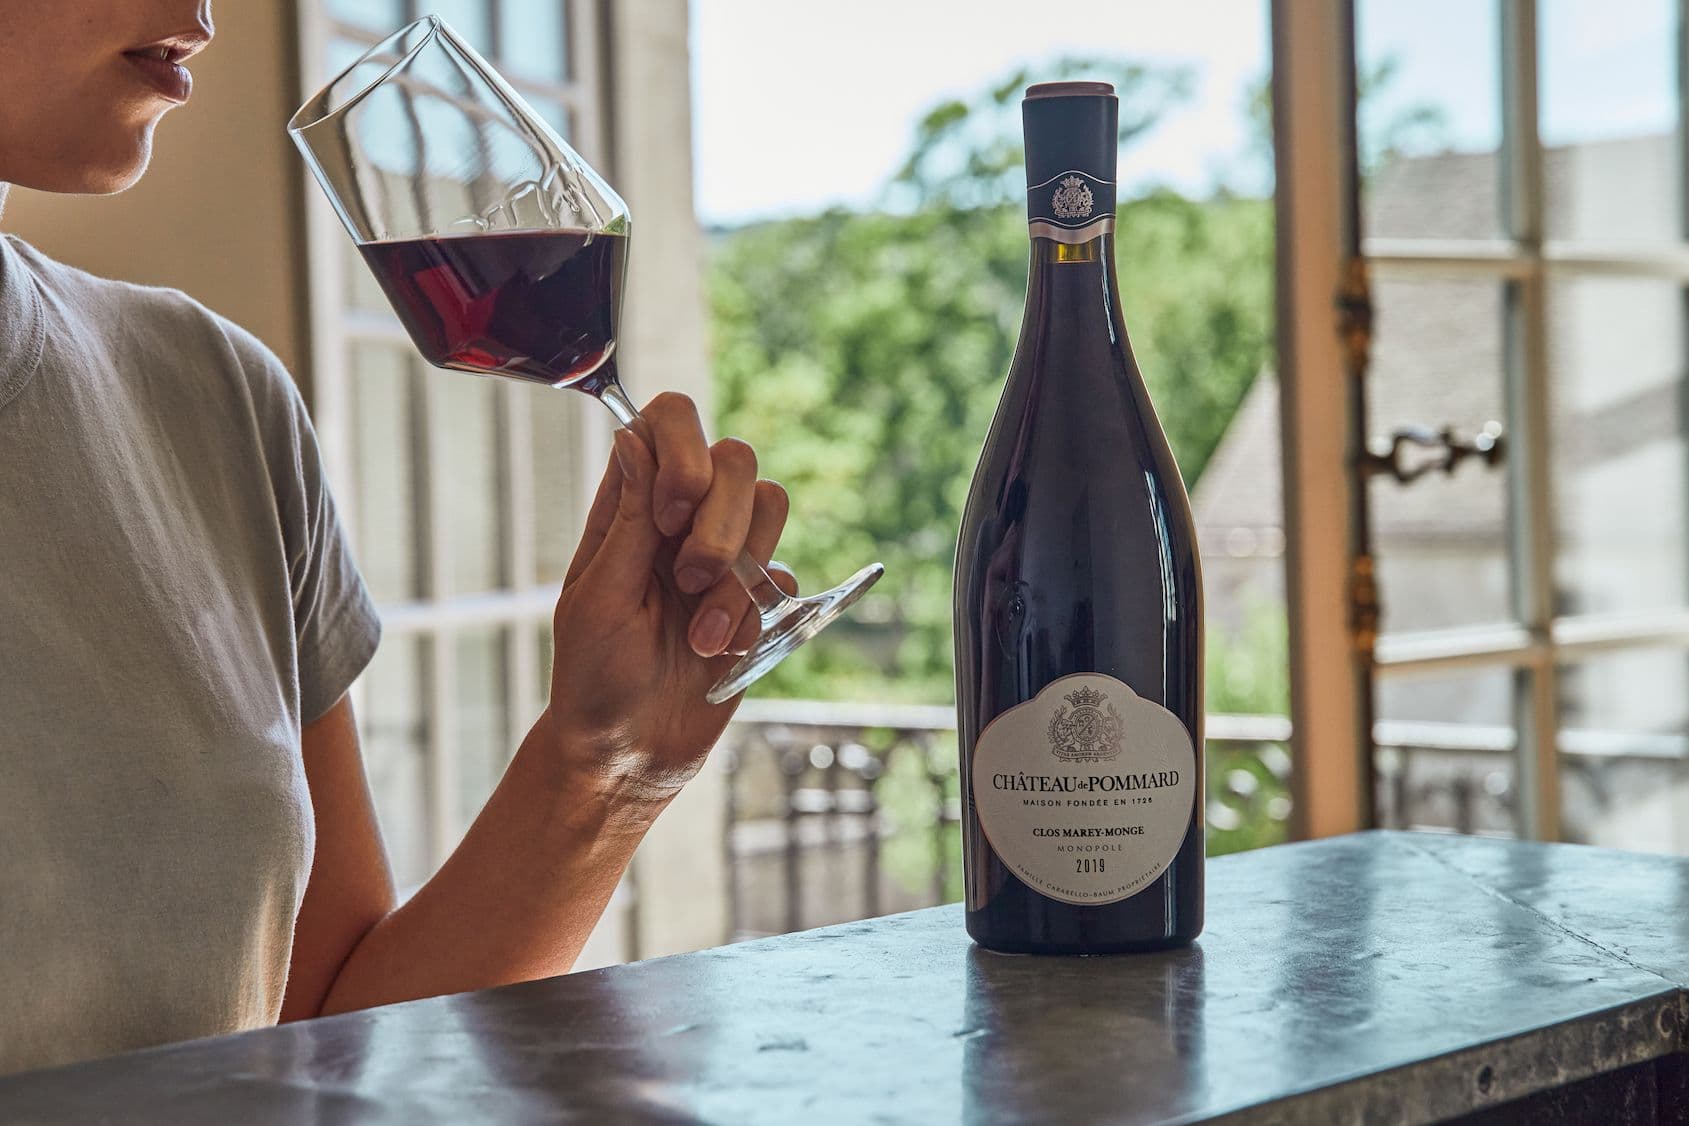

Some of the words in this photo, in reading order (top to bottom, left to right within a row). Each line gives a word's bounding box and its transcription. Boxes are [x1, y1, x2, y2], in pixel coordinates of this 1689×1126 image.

[993, 771, 1077, 792] CHÂTEAU
[1077, 780, 1088, 789] de
[1088, 771, 1179, 792] POMMARD
[1023, 799, 1061, 807] MAISON
[1067, 798, 1108, 807] FONDÉE
[1033, 828, 1060, 837] CLOS
[1062, 826, 1145, 837] MAREY-MONGE
[1057, 844, 1122, 852] MONOPOLE
[1076, 859, 1105, 873] 2019
